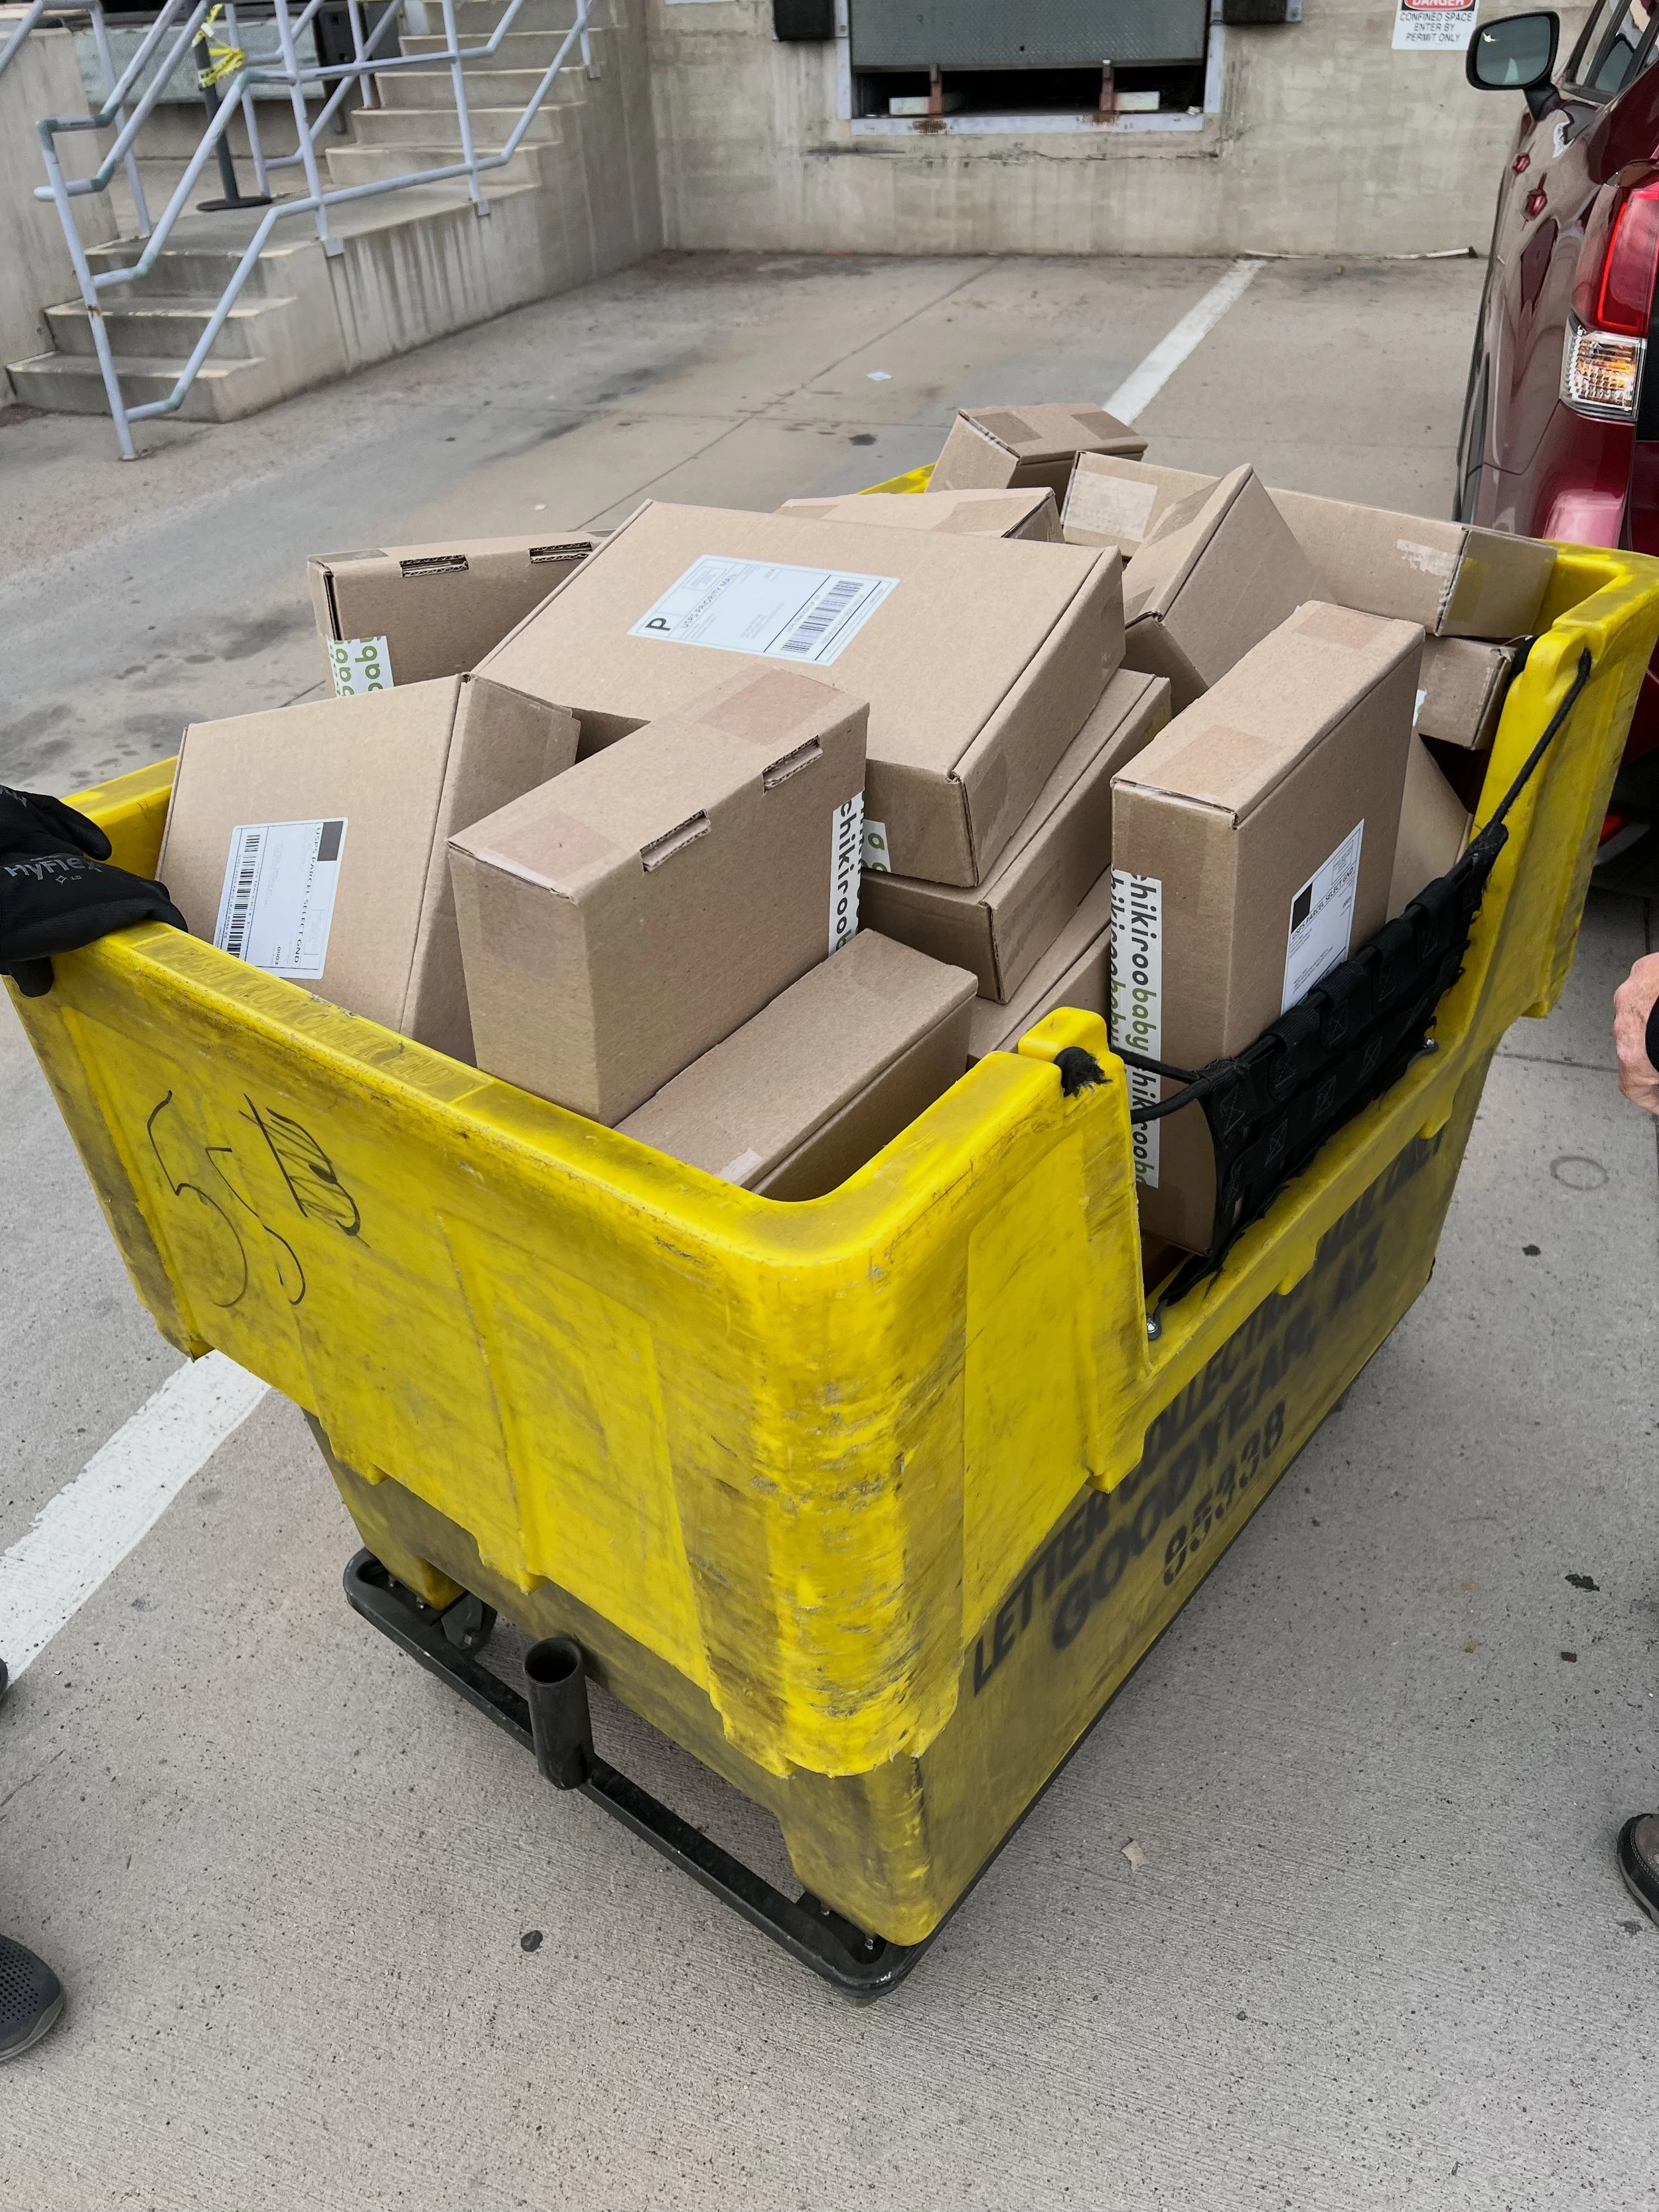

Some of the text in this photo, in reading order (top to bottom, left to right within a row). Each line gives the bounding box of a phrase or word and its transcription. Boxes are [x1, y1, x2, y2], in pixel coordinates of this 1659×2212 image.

[1400, 12, 1473, 22] CONFINED SPACE
[1413, 23, 1455, 32] ENTER BY
[1406, 33, 1461, 42] PERMIT ONLY
[680, 613, 699, 628] USPS
[694, 587, 722, 615] PRIORITY
[720, 572, 738, 588] MAIL
[645, 617, 671, 632] P
[312, 828, 322, 855] USPS
[305, 856, 316, 894] PARCEL
[299, 899, 309, 935] SELECT
[1291, 922, 1306, 940] USPS
[1305, 901, 1325, 926] PARCEL
[1325, 880, 1342, 903] SELECT
[1342, 866, 1354, 883] GND
[293, 938, 303, 964] GND
[171, 945, 237, 984] PUSH
[226, 972, 302, 1016] FROM
[295, 1010, 390, 1059] OTHER
[384, 1051, 455, 1086] END
[974, 1489, 1112, 1697] LETTER
